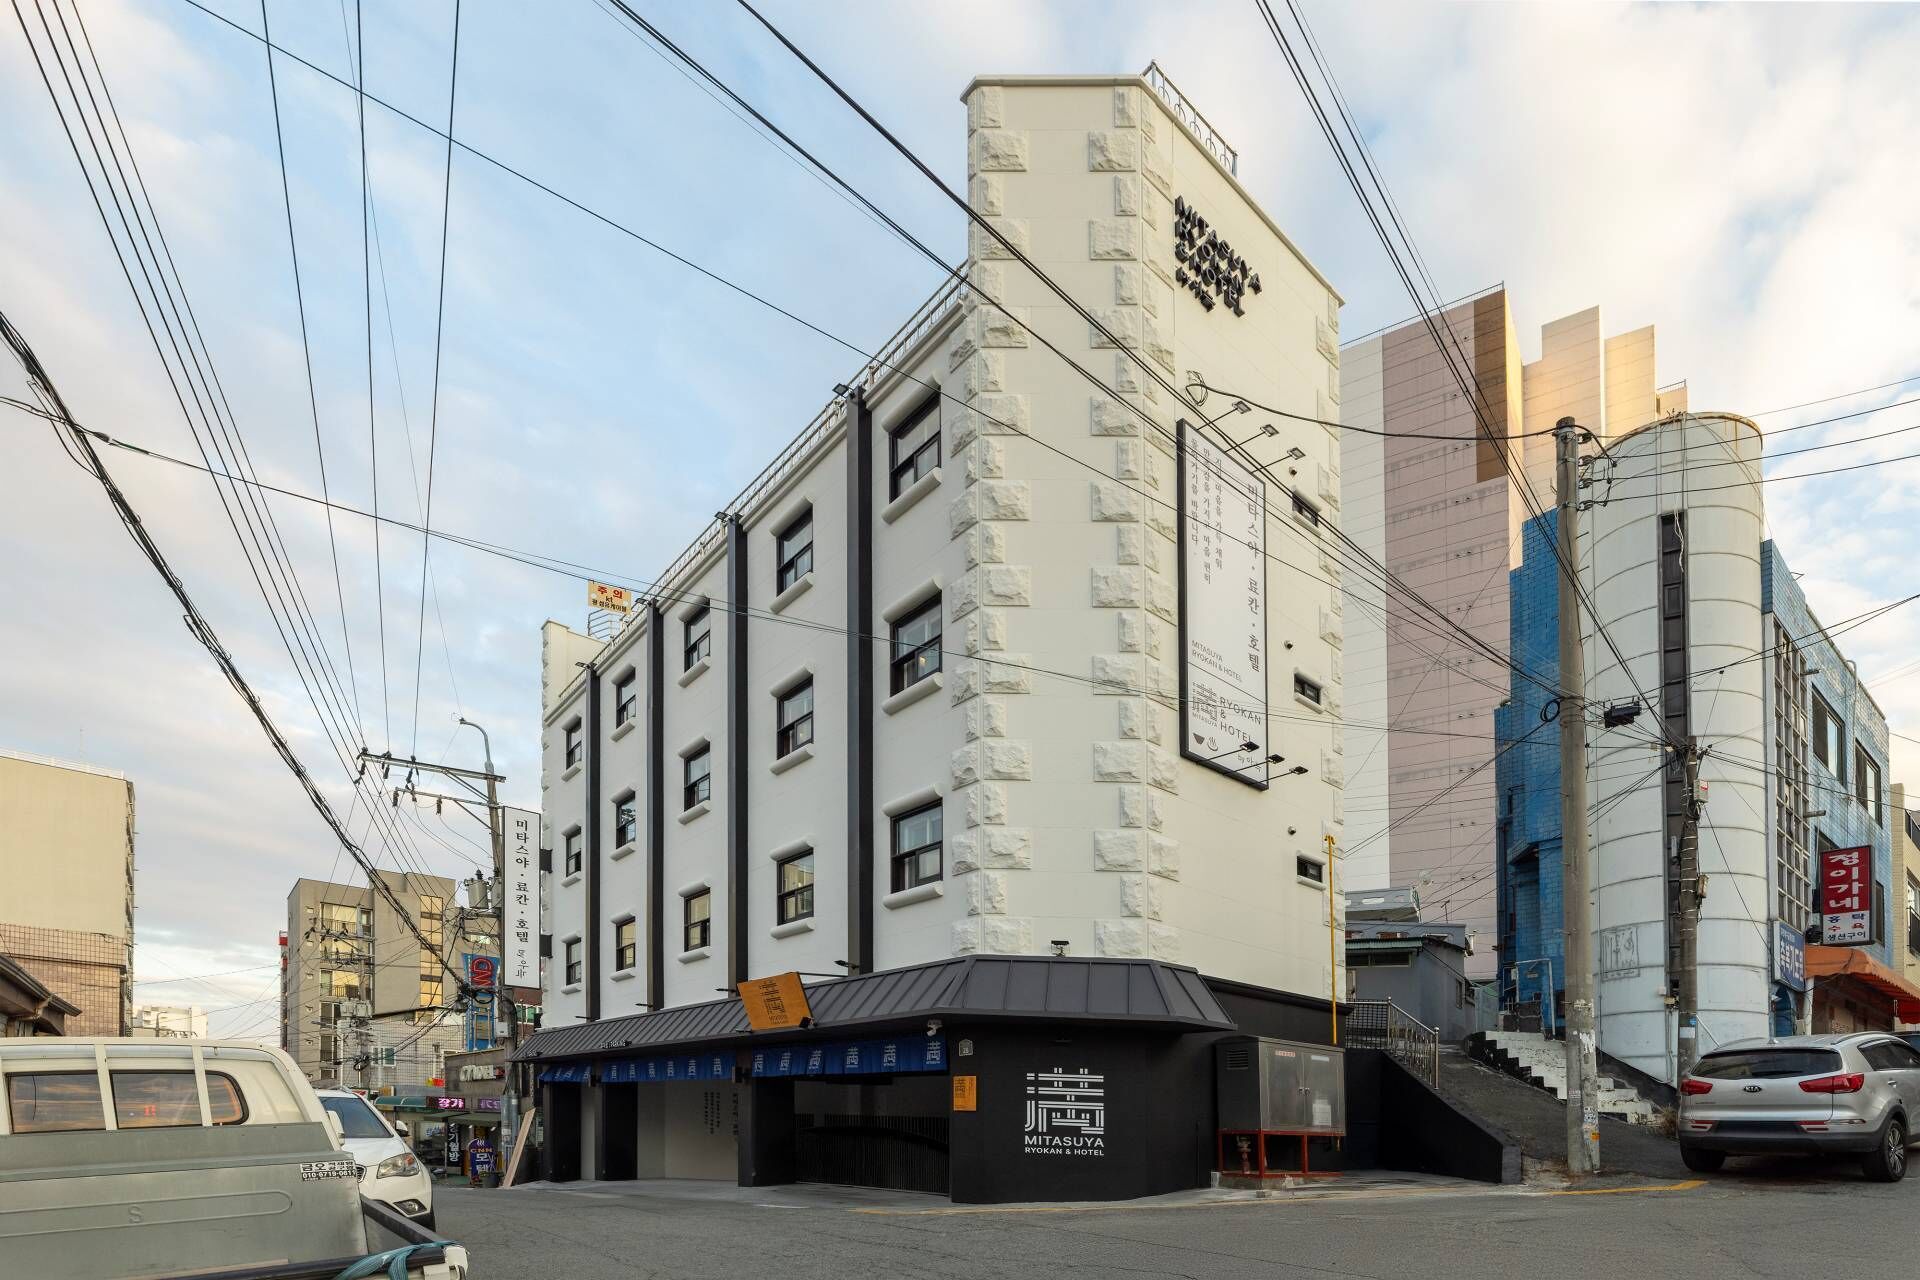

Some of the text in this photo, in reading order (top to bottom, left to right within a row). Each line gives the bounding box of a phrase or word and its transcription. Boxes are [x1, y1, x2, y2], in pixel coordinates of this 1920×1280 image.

[597, 586, 623, 599] 주의
[1247, 577, 1260, 615] 료칸
[1248, 634, 1260, 673] 호텔
[1220, 697, 1261, 725] RYOKAN
[515, 819, 529, 869] 미타스야
[515, 881, 529, 905] 료칸
[515, 919, 529, 943] 호텔
[1828, 931, 1866, 941] 생선구이
[1024, 1135, 1105, 1147] MITASUYA
[1024, 1147, 1063, 1155] RYOKAN
